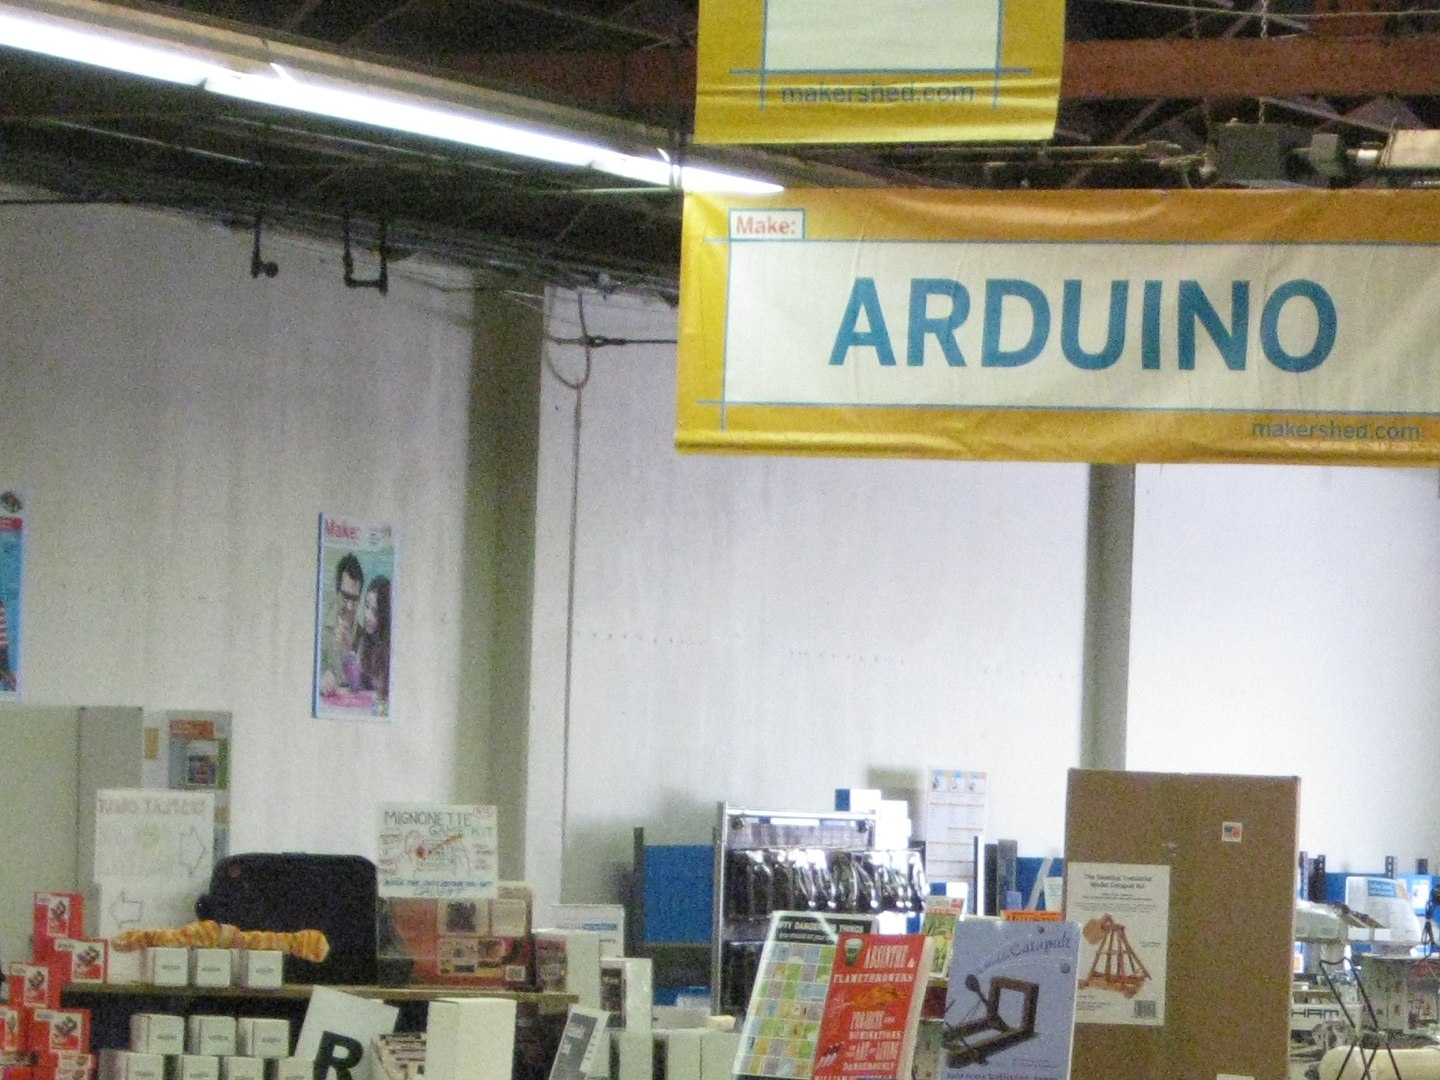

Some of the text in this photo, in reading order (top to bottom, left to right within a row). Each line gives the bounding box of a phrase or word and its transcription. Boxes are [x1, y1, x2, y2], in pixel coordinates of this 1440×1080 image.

[782, 80, 976, 103] makershed.com
[735, 215, 797, 235] Make:
[828, 277, 1338, 373] ARDUINO
[1252, 419, 1422, 440] makershed.com
[384, 810, 473, 827] MIGNONETTE
